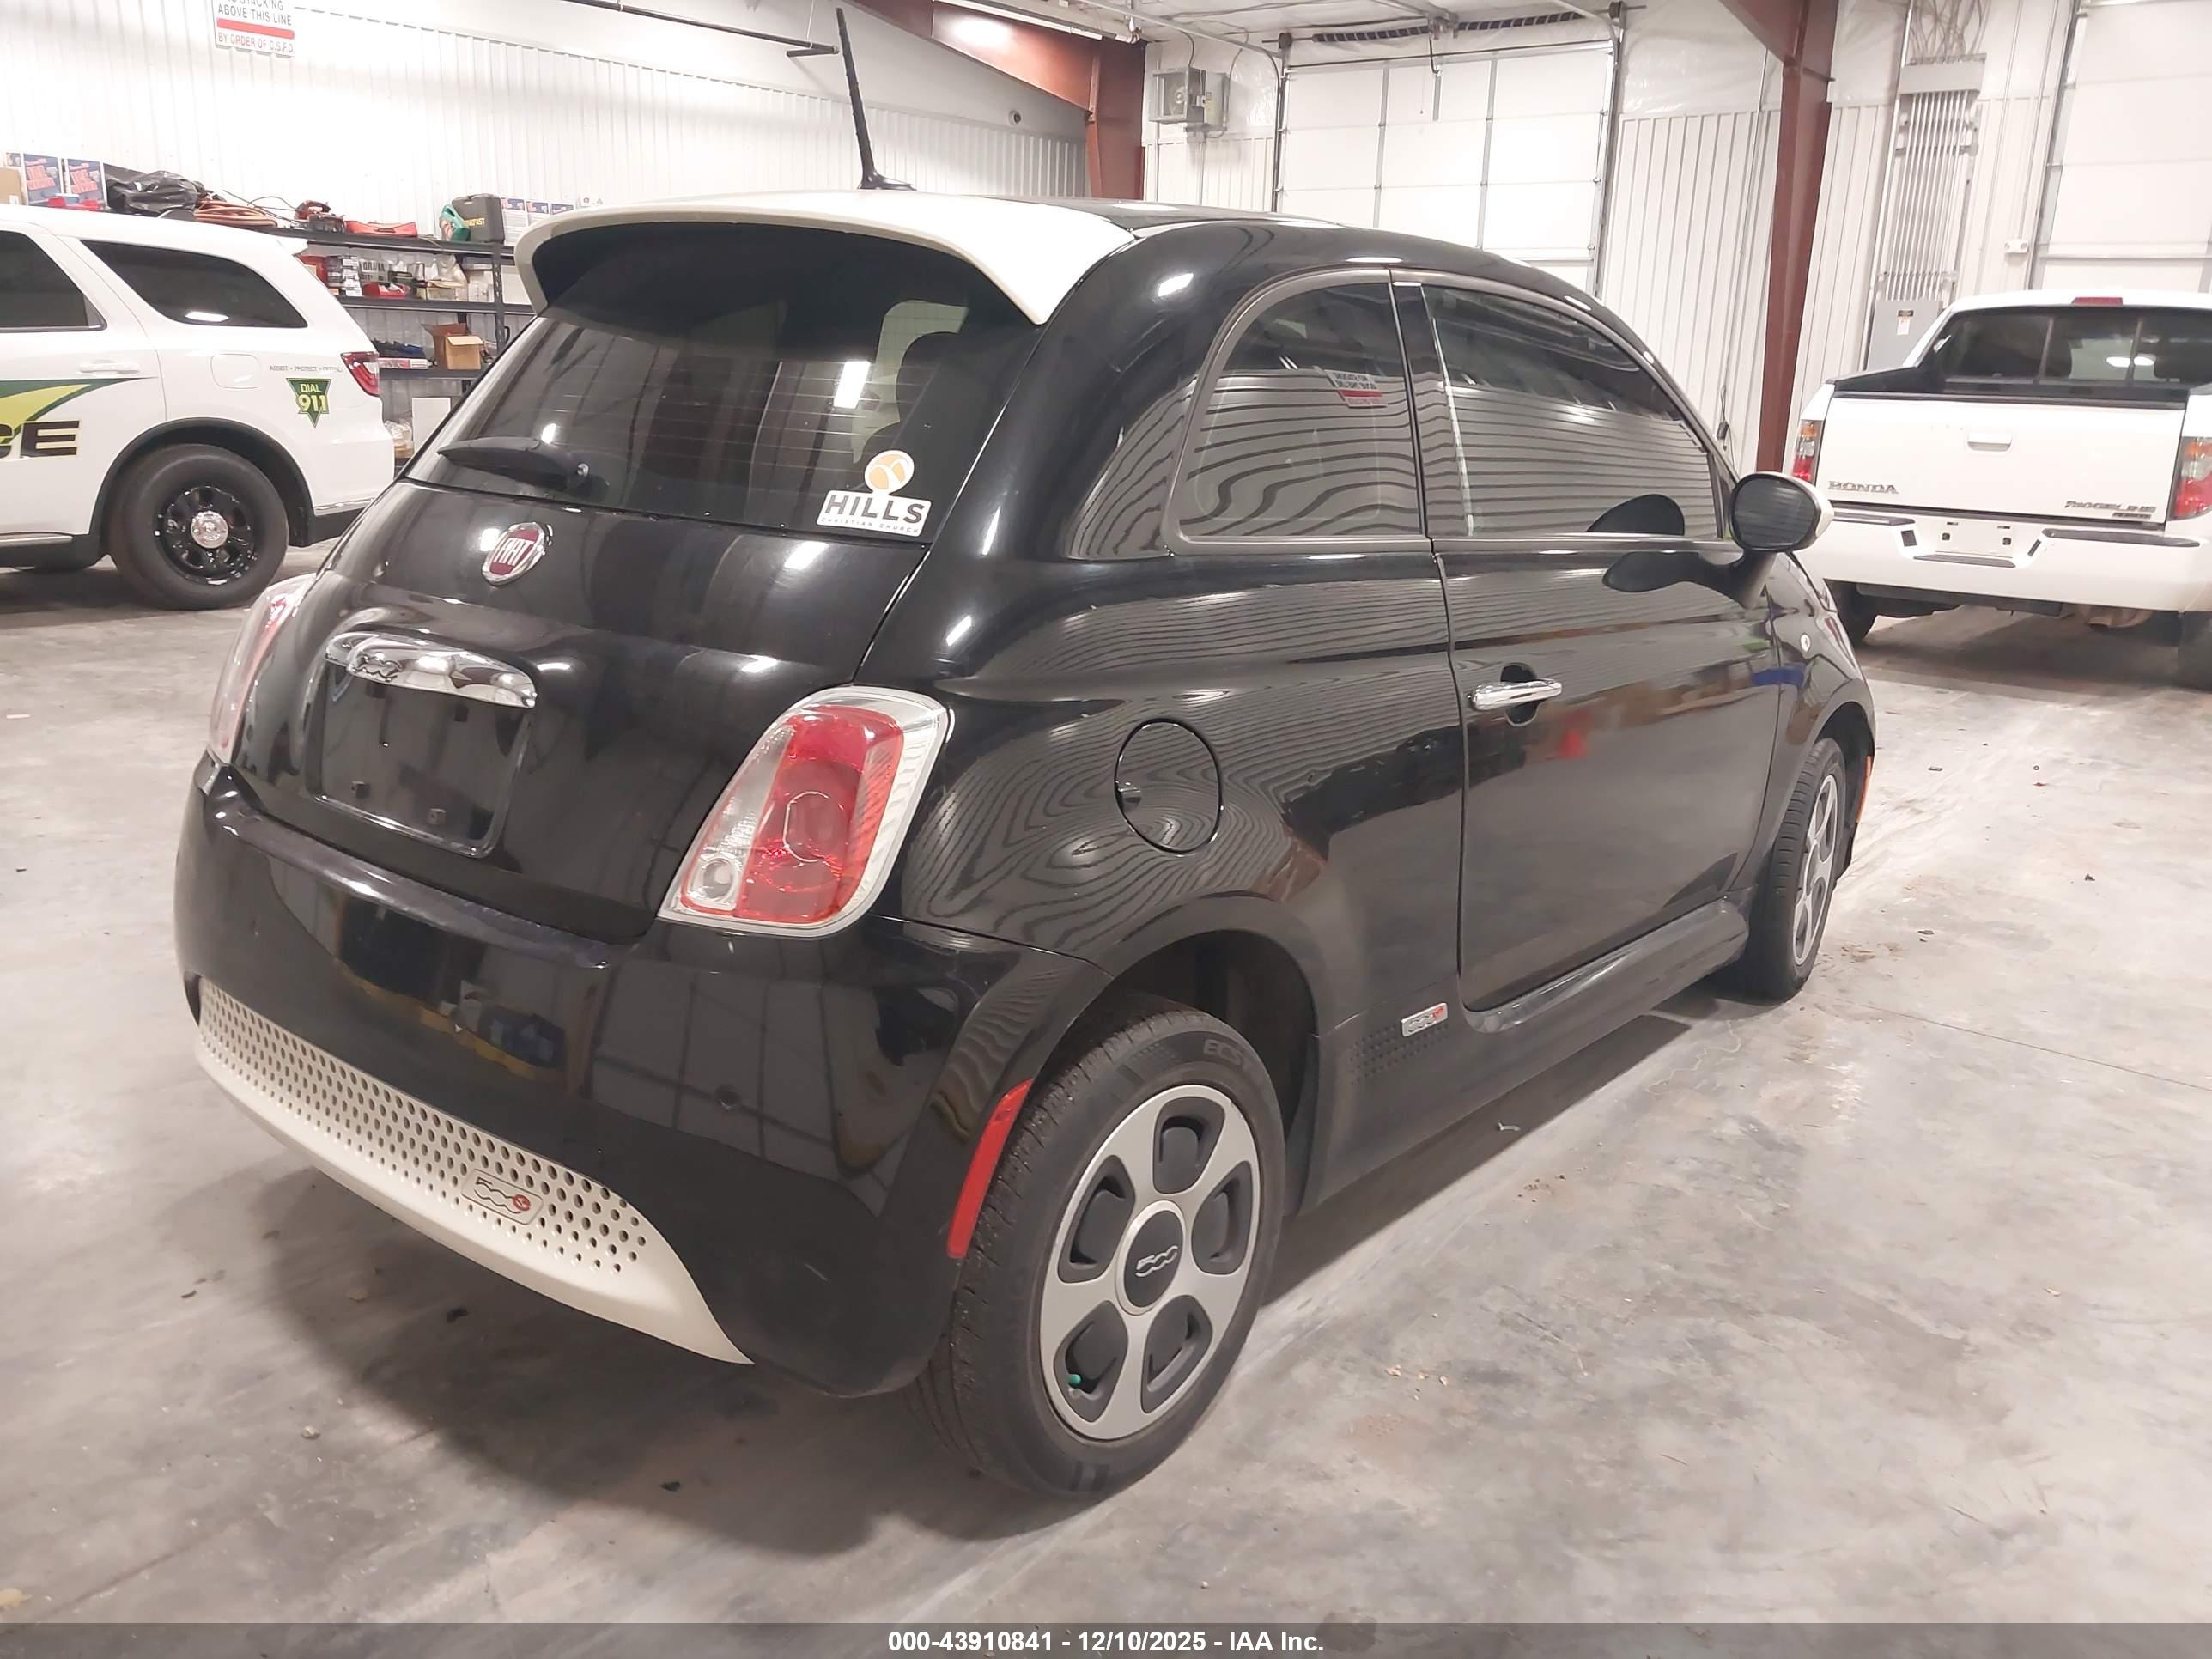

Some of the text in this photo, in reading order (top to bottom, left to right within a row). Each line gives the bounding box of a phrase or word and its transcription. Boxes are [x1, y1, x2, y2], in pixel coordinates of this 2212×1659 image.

[217, 3, 292, 26] ABOVE THIS LINE
[217, 32, 228, 43] BY
[230, 33, 256, 47] ORDER
[258, 39, 267, 49] OF
[301, 383, 322, 393] DIAL
[298, 394, 329, 412] 911
[1827, 480, 1899, 495] HONDA
[824, 494, 925, 524] HILLS
[821, 517, 919, 533] CHRISTIAN CHURCH
[492, 537, 535, 567] FIAT
[1135, 1245, 1178, 1278] 500
